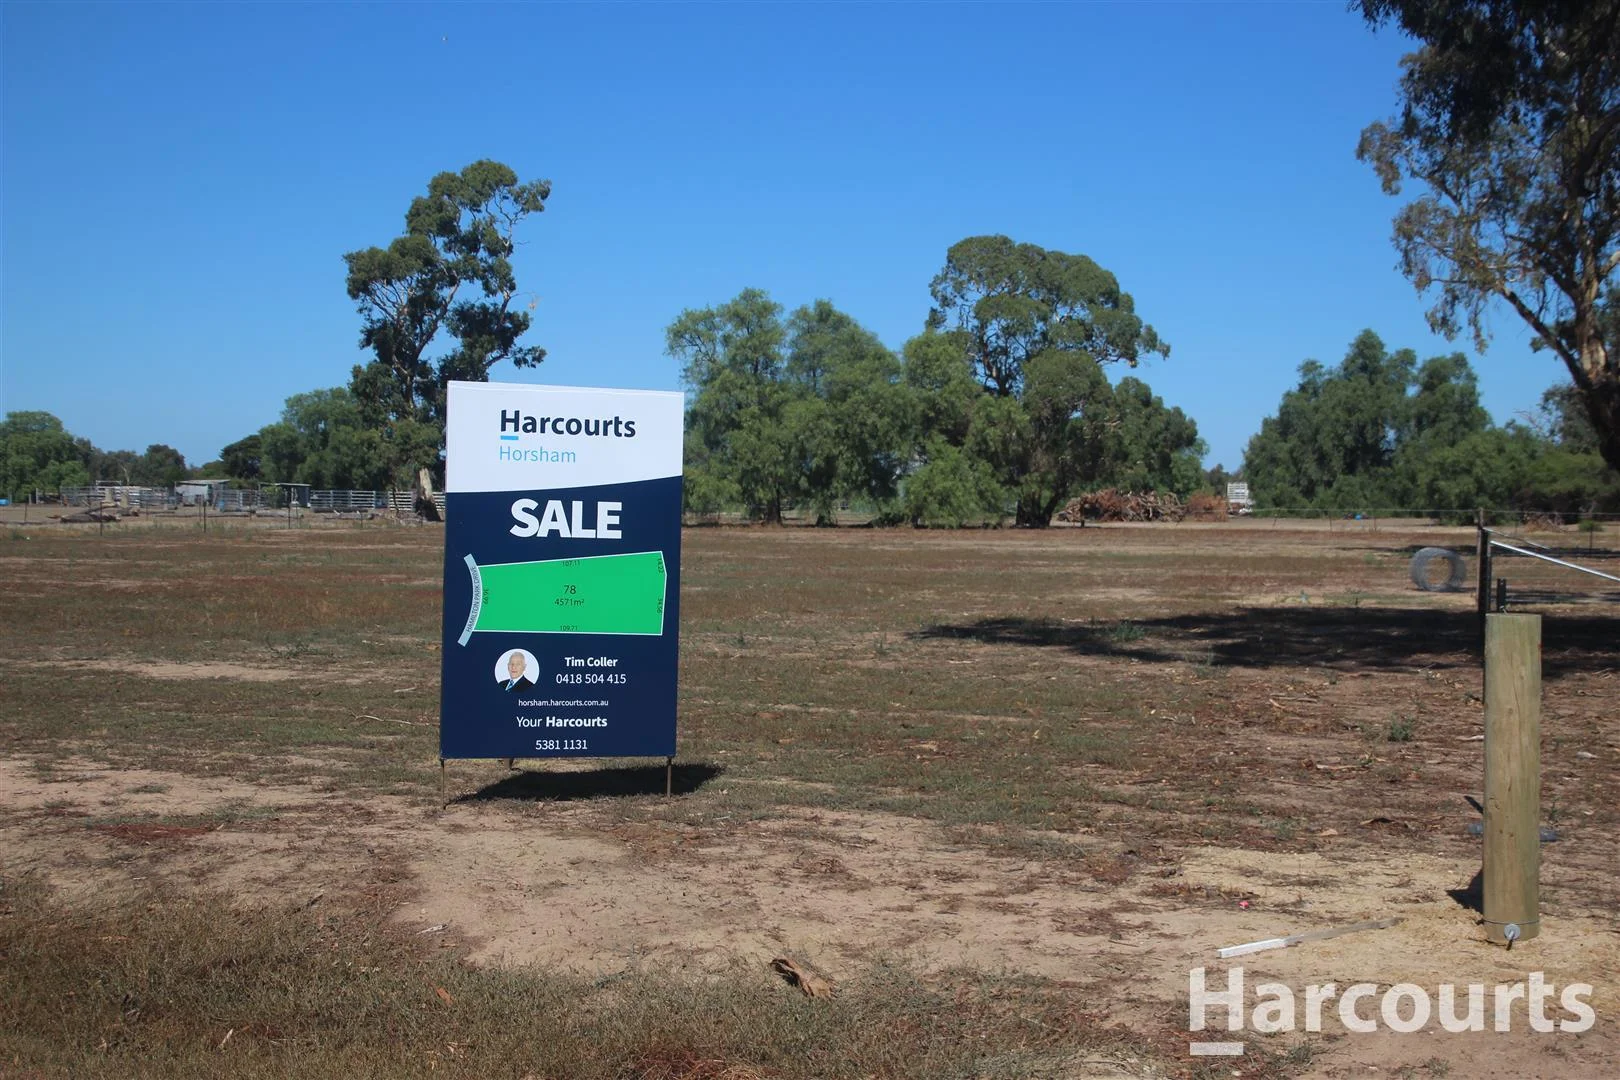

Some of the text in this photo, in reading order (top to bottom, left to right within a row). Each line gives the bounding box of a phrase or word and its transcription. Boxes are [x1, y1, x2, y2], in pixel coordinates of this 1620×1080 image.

[500, 409, 636, 438] Harcourts
[500, 446, 576, 463] Horsham
[509, 498, 622, 539] SALE
[470, 567, 479, 584] DRIVE
[564, 585, 576, 595] 78
[466, 601, 479, 632] HAMILTON
[565, 656, 618, 667] Tim Coller
[556, 674, 627, 684] 0418 504 415
[516, 716, 608, 727] Your Harcourts
[535, 740, 587, 750] 5381 1131
